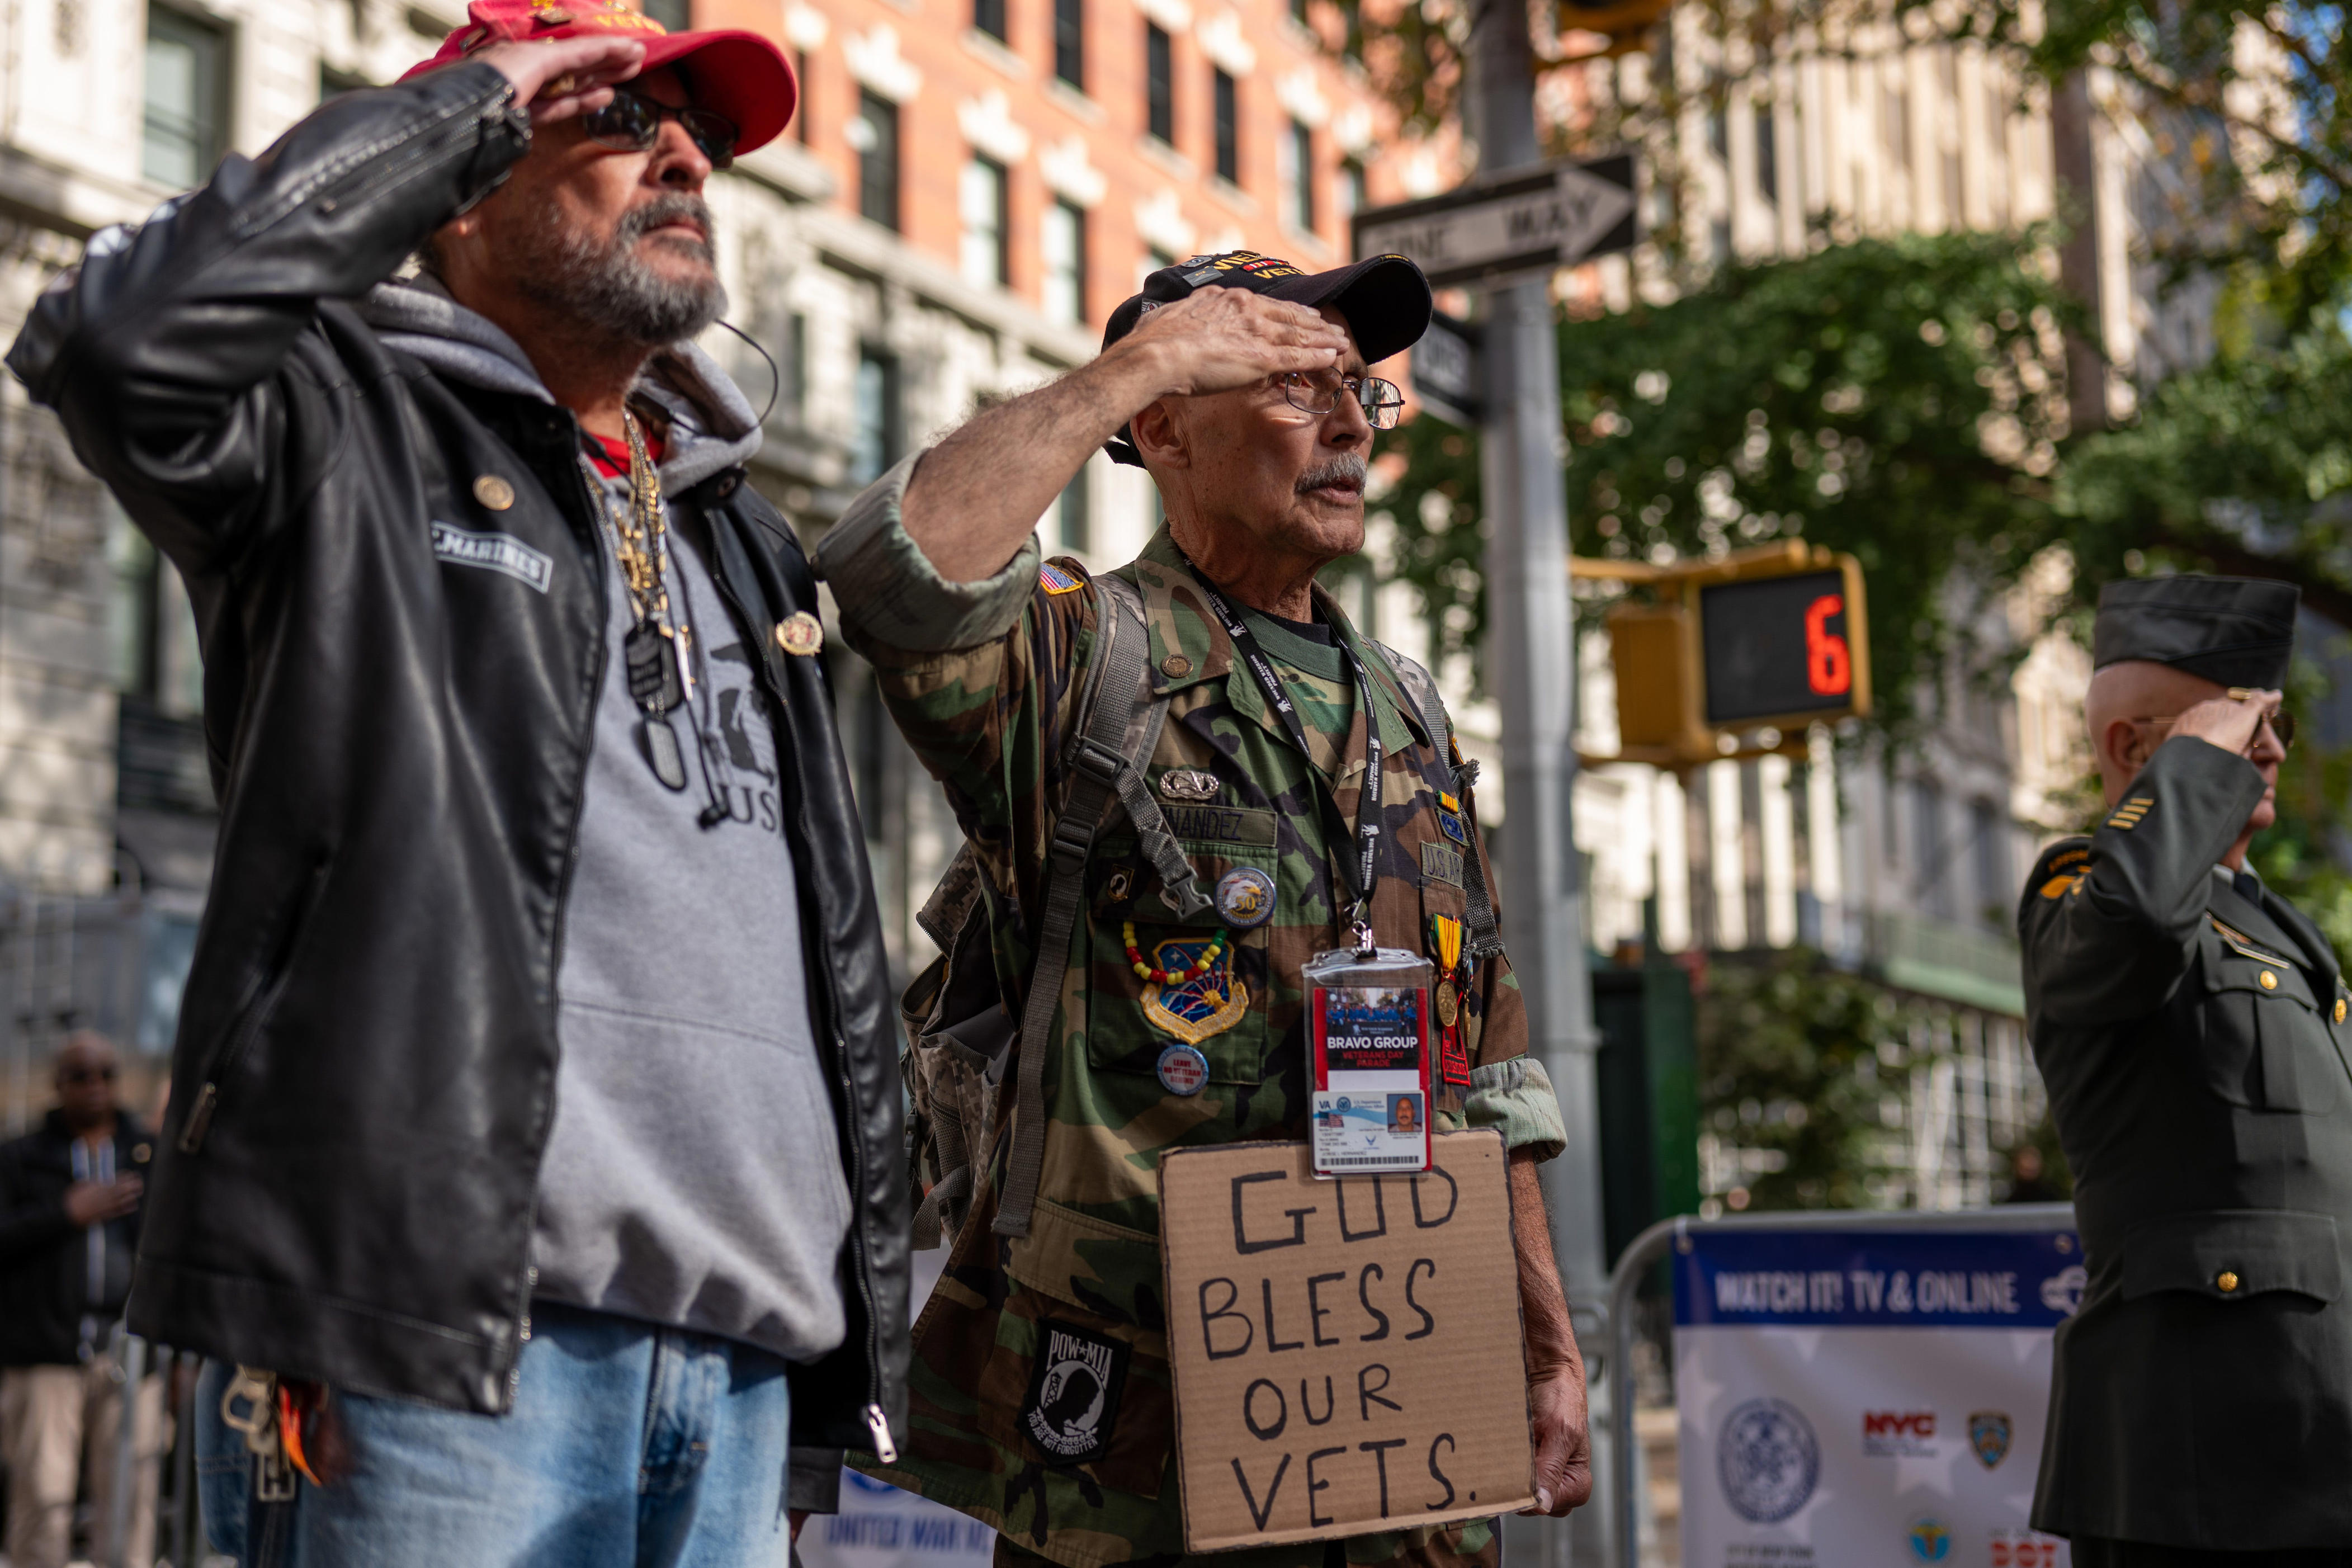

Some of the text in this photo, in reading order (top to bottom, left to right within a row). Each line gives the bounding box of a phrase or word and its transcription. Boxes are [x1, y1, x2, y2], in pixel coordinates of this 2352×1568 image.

[443, 532, 541, 579] MARINES
[1805, 594, 1851, 696] 6
[1173, 1059, 1191, 1068] LEAVE
[1327, 1036, 1418, 1049] BRAVO GROUP
[1343, 1051, 1386, 1059] VETERANS
[1319, 1101, 1331, 1109] VA
[1232, 1165, 1458, 1254] GOD
[1199, 1258, 1436, 1361] BLESS
[1715, 1271, 2019, 1314] WATCH IT! TV & ONLINE
[1244, 1363, 1402, 1441] OUR
[1863, 1410, 1937, 1438] NYC
[1028, 1410, 1098, 1455] YOU ARE NOT FORGOTTEN
[1231, 1433, 1477, 1532] VETS.
